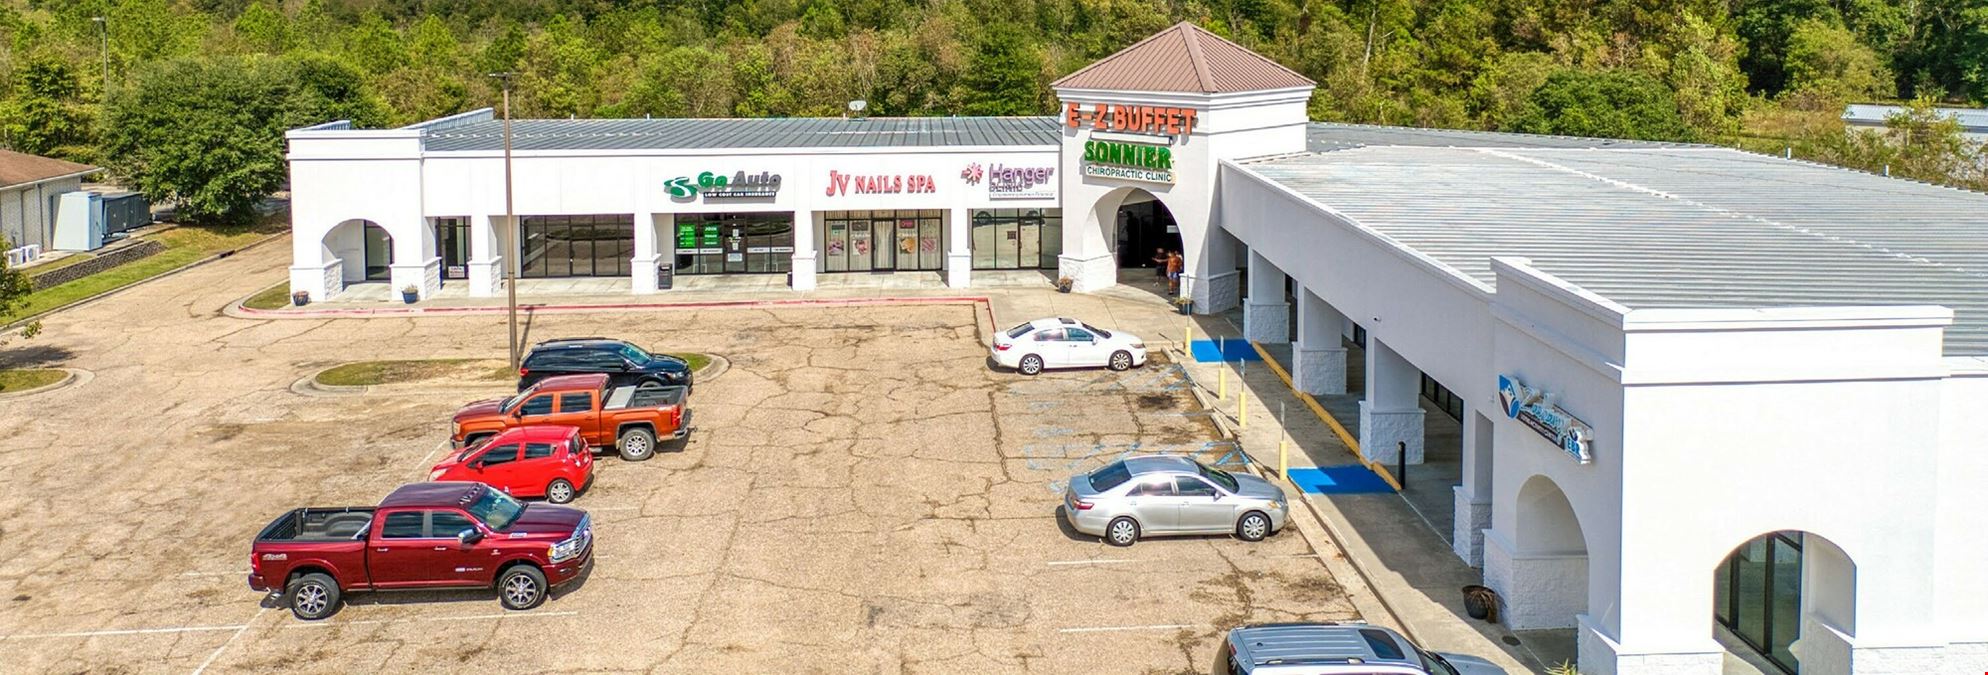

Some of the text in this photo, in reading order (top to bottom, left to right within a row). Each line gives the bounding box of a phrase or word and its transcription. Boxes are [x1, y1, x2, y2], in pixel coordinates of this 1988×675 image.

[1067, 102, 1197, 135] E-Z BUFFET
[1084, 140, 1172, 170] SONNIER
[698, 170, 782, 188] Go Auto
[826, 170, 936, 197] JV NAILS SPA
[989, 163, 1055, 186] Hanger
[1087, 166, 1172, 182] CHIROPRACTIC CLINIC
